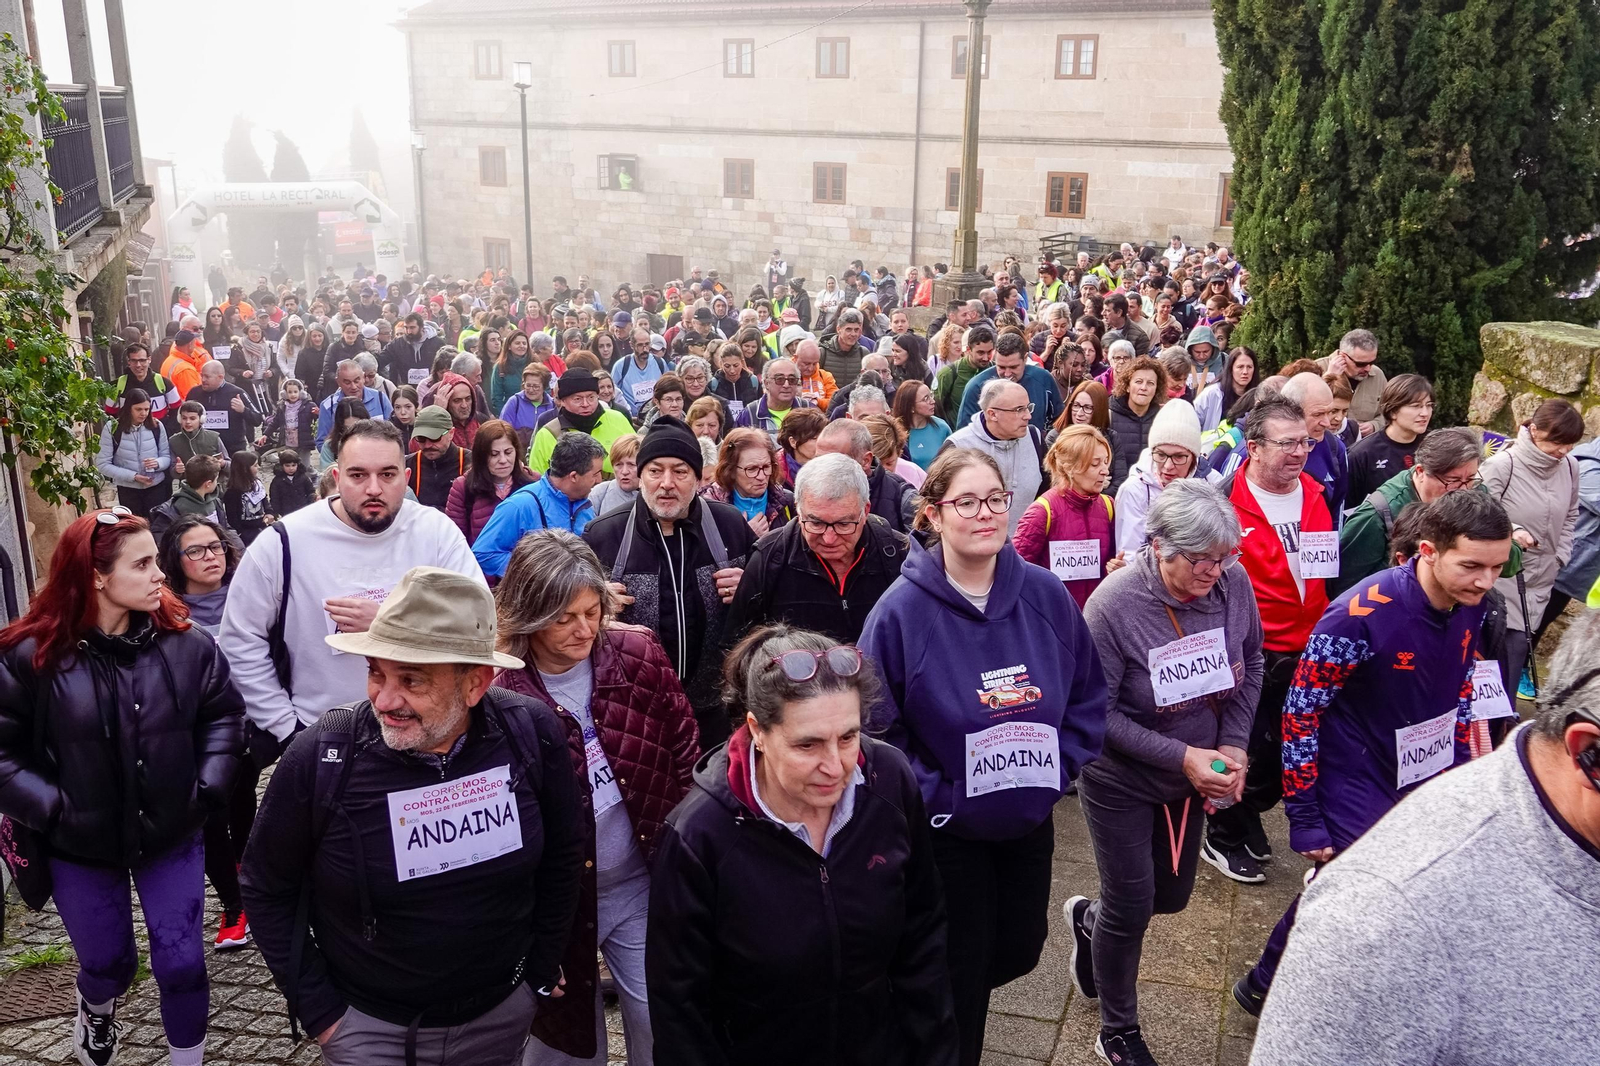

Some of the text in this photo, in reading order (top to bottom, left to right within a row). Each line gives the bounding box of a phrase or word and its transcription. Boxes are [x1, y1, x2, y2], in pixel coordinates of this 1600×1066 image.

[214, 191, 255, 201] HOTEL
[262, 191, 278, 201] LA
[1055, 555, 1099, 568] ANDAINA
[344, 588, 385, 599] RREMOS
[368, 591, 390, 600] CANC
[1156, 646, 1182, 660] CONTRA
[1190, 637, 1218, 649] CANCRO
[1167, 634, 1206, 650] CORREMOS
[980, 664, 1027, 681] LIGHTNING
[1160, 652, 1228, 685] ANDAINA
[983, 676, 1016, 690] STRIKES
[1472, 682, 1506, 702] DAINA
[974, 734, 1004, 747] CONTRA
[1014, 731, 1049, 739] CANCRO
[987, 725, 1035, 737] CORREMOS
[1402, 729, 1428, 741] CONTRA
[1401, 735, 1452, 769] ANDAINA
[972, 750, 1054, 777] ANDAINA
[403, 779, 503, 811] CONTRA O CANCRO
[423, 776, 487, 799] CORREMOS
[407, 801, 515, 850] ANDAINA
